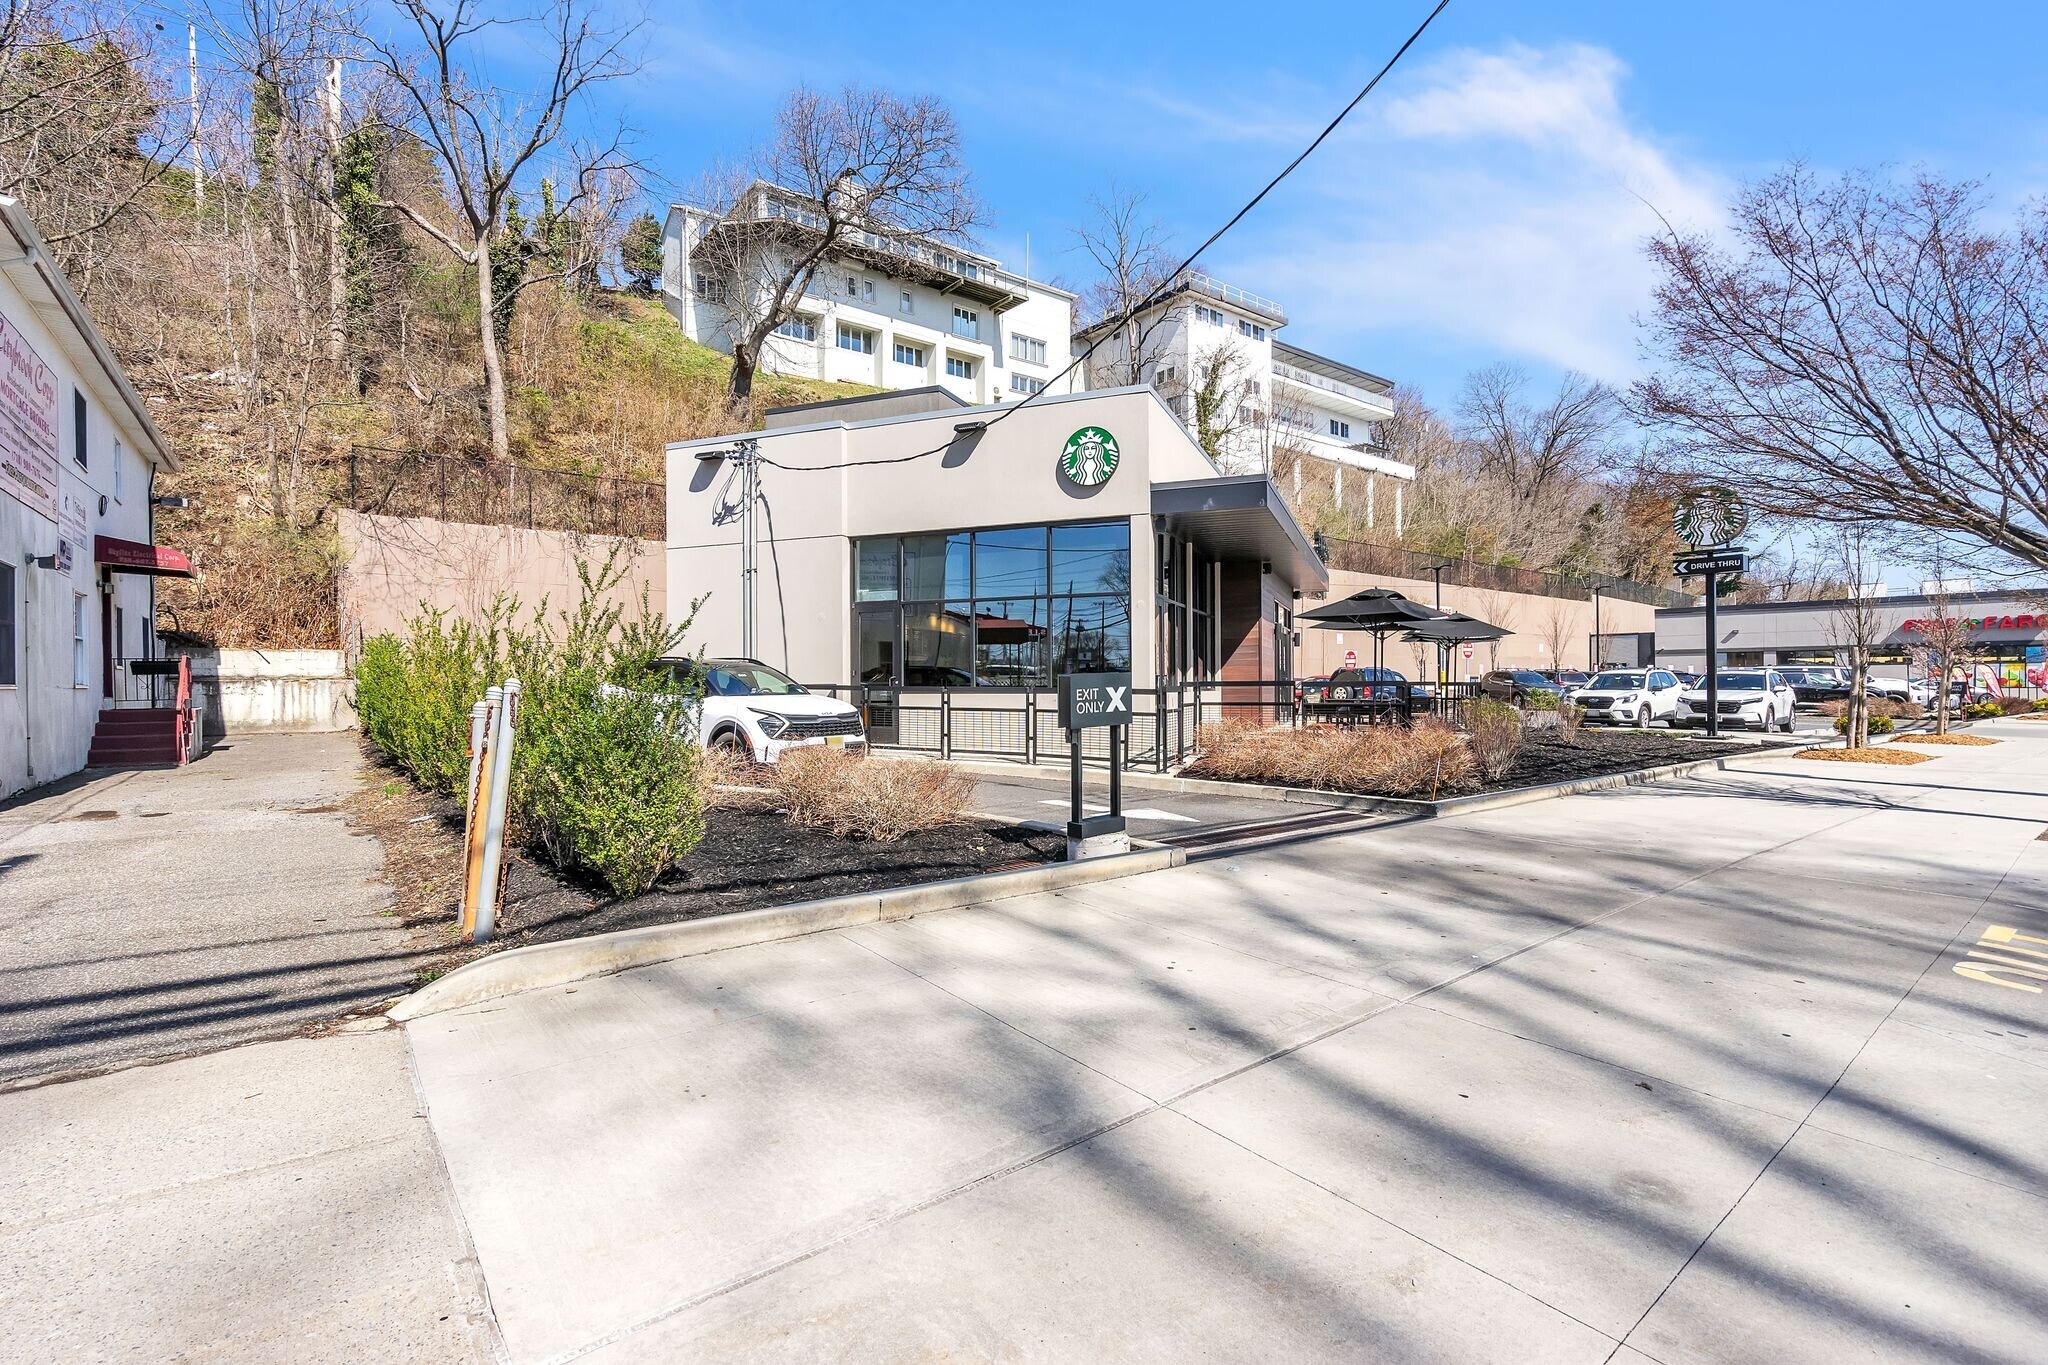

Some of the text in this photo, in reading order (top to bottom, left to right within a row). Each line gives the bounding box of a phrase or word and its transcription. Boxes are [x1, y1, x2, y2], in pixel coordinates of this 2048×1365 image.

[1690, 559, 1741, 570] DRIVE THRU
[1076, 688, 1099, 701] EXIT
[1076, 701, 1105, 715] ONLY
